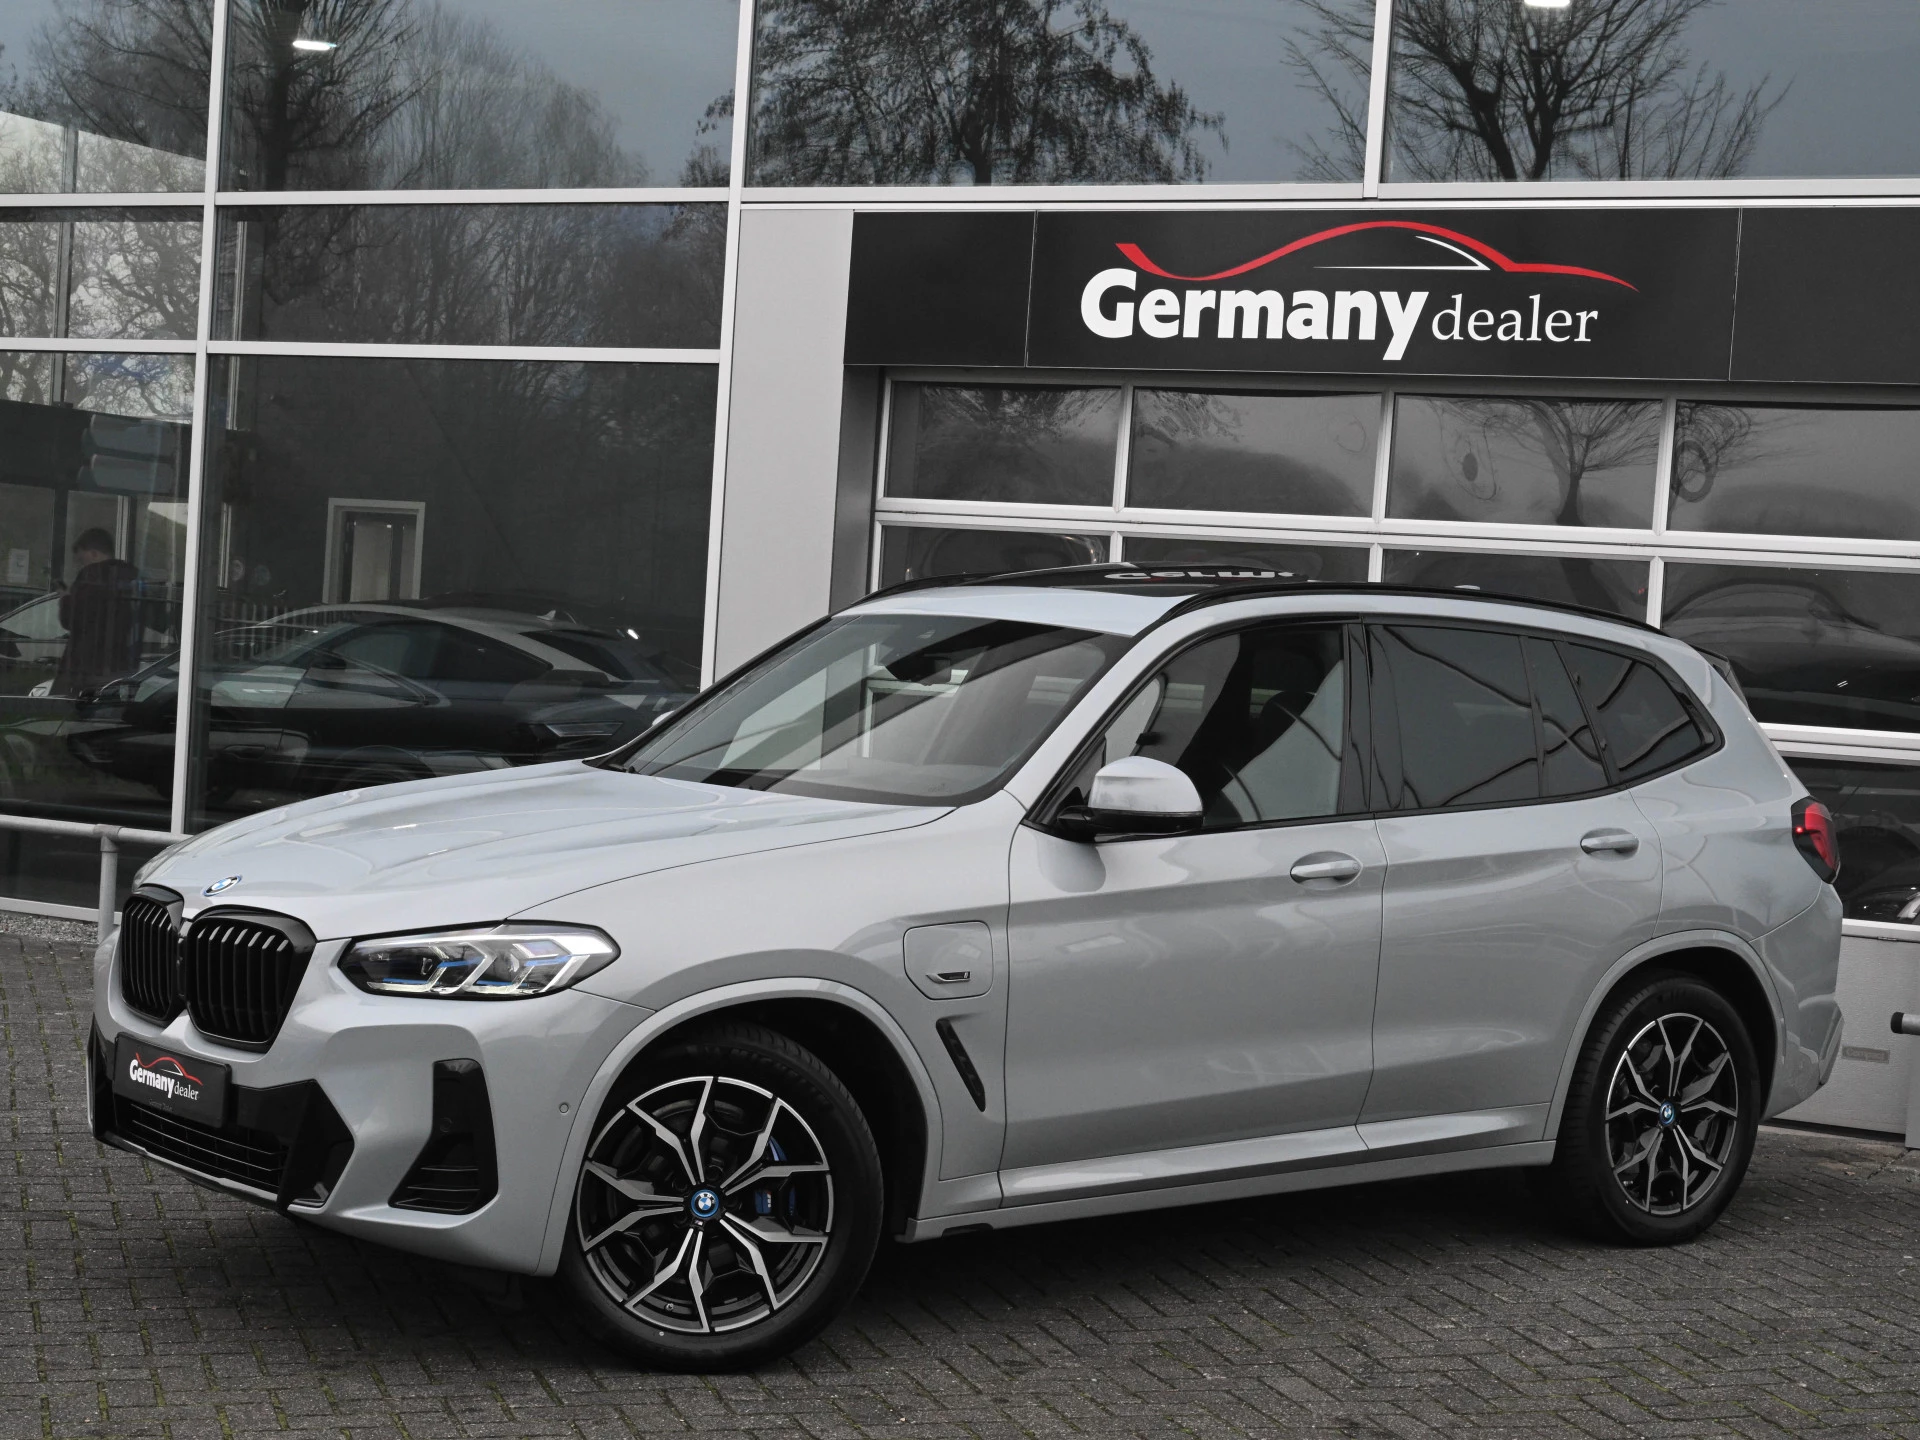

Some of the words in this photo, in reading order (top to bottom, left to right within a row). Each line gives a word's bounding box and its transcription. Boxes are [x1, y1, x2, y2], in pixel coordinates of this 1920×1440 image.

[1081, 268, 1429, 361] Germany
[1431, 294, 1598, 343] dealer
[129, 1059, 175, 1099] Germany
[174, 1081, 199, 1101] dealer
